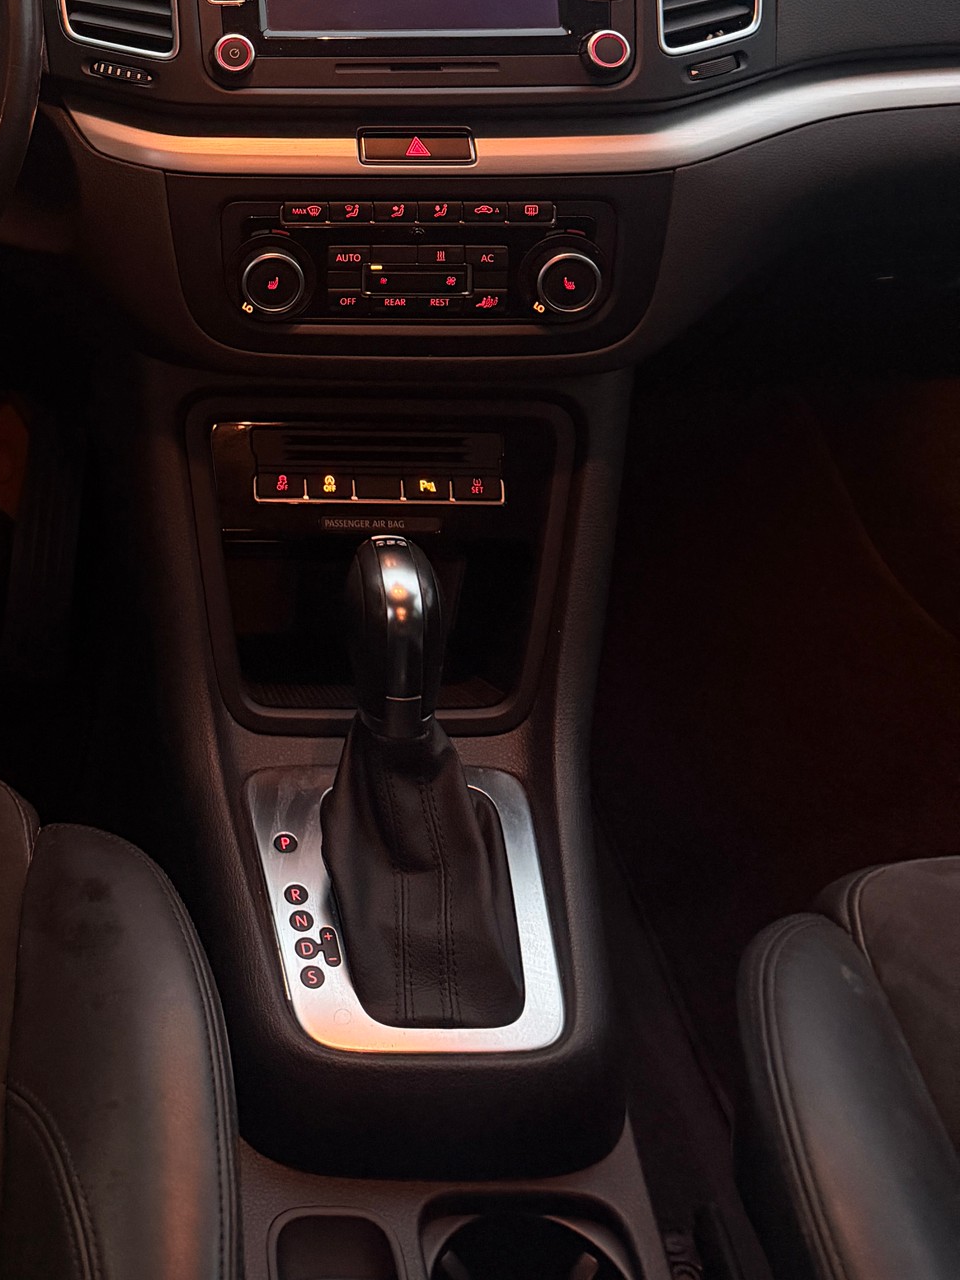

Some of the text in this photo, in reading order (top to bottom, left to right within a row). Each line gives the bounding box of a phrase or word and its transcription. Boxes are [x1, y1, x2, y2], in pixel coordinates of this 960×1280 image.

[336, 253, 361, 263] AUTO
[480, 253, 495, 263] AC
[340, 297, 357, 306] OFF
[384, 298, 406, 307] REAR
[430, 297, 450, 307] REST
[323, 484, 336, 492] OFF
[471, 486, 484, 494] SET
[324, 520, 405, 529] PASSENGER AIR BAG
[280, 837, 290, 850] P
[290, 888, 301, 901] R
[295, 915, 308, 928] N
[301, 942, 314, 955] D
[308, 971, 317, 984] S
